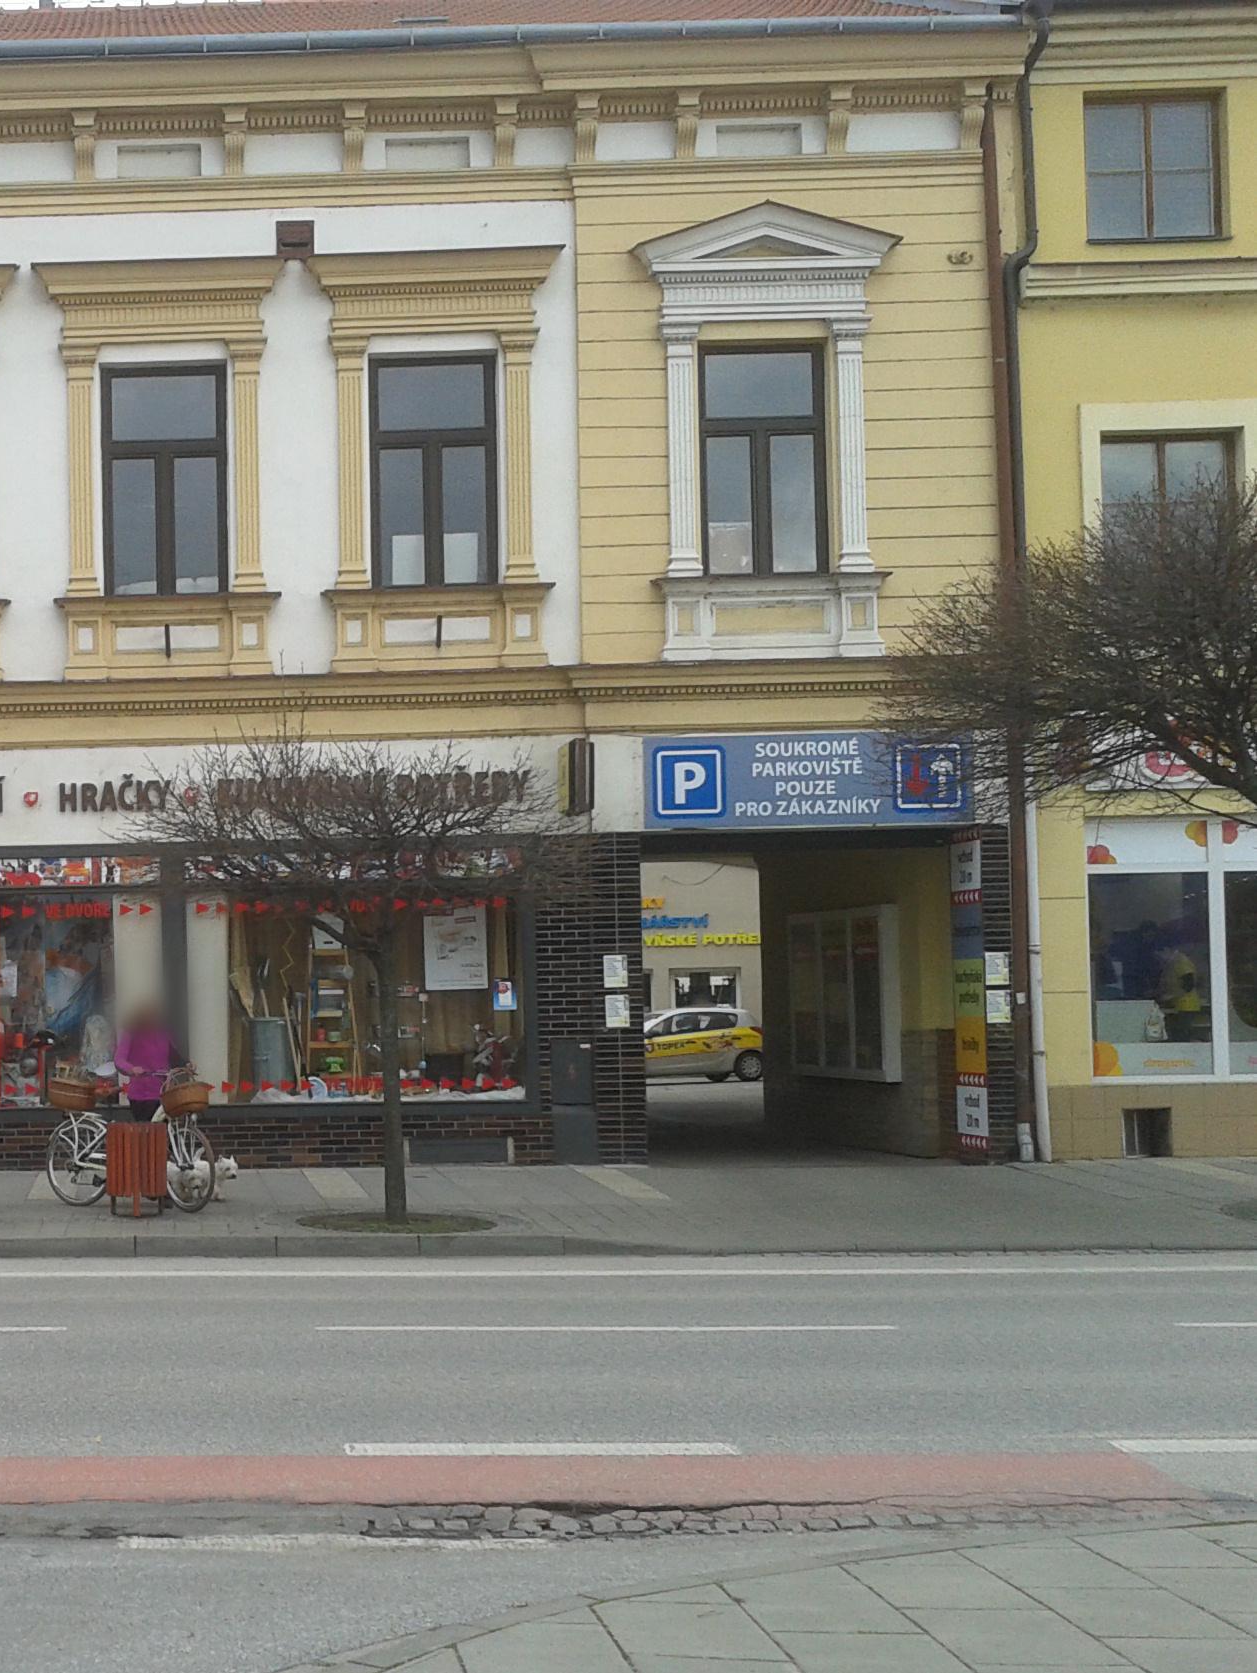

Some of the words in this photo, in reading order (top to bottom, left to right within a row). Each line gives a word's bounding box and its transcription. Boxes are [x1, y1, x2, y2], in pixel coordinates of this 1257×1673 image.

[754, 737, 860, 758] SOUKROMÉ
[751, 755, 864, 778] PARKOVIŠTĚ
[58, 773, 172, 813] HRAČKY
[673, 761, 707, 806] P
[775, 780, 836, 797] POUZE
[734, 801, 773, 818] PRO
[775, 797, 882, 817] ZÁKAZNÍKY
[702, 930, 761, 946] POTŘE
